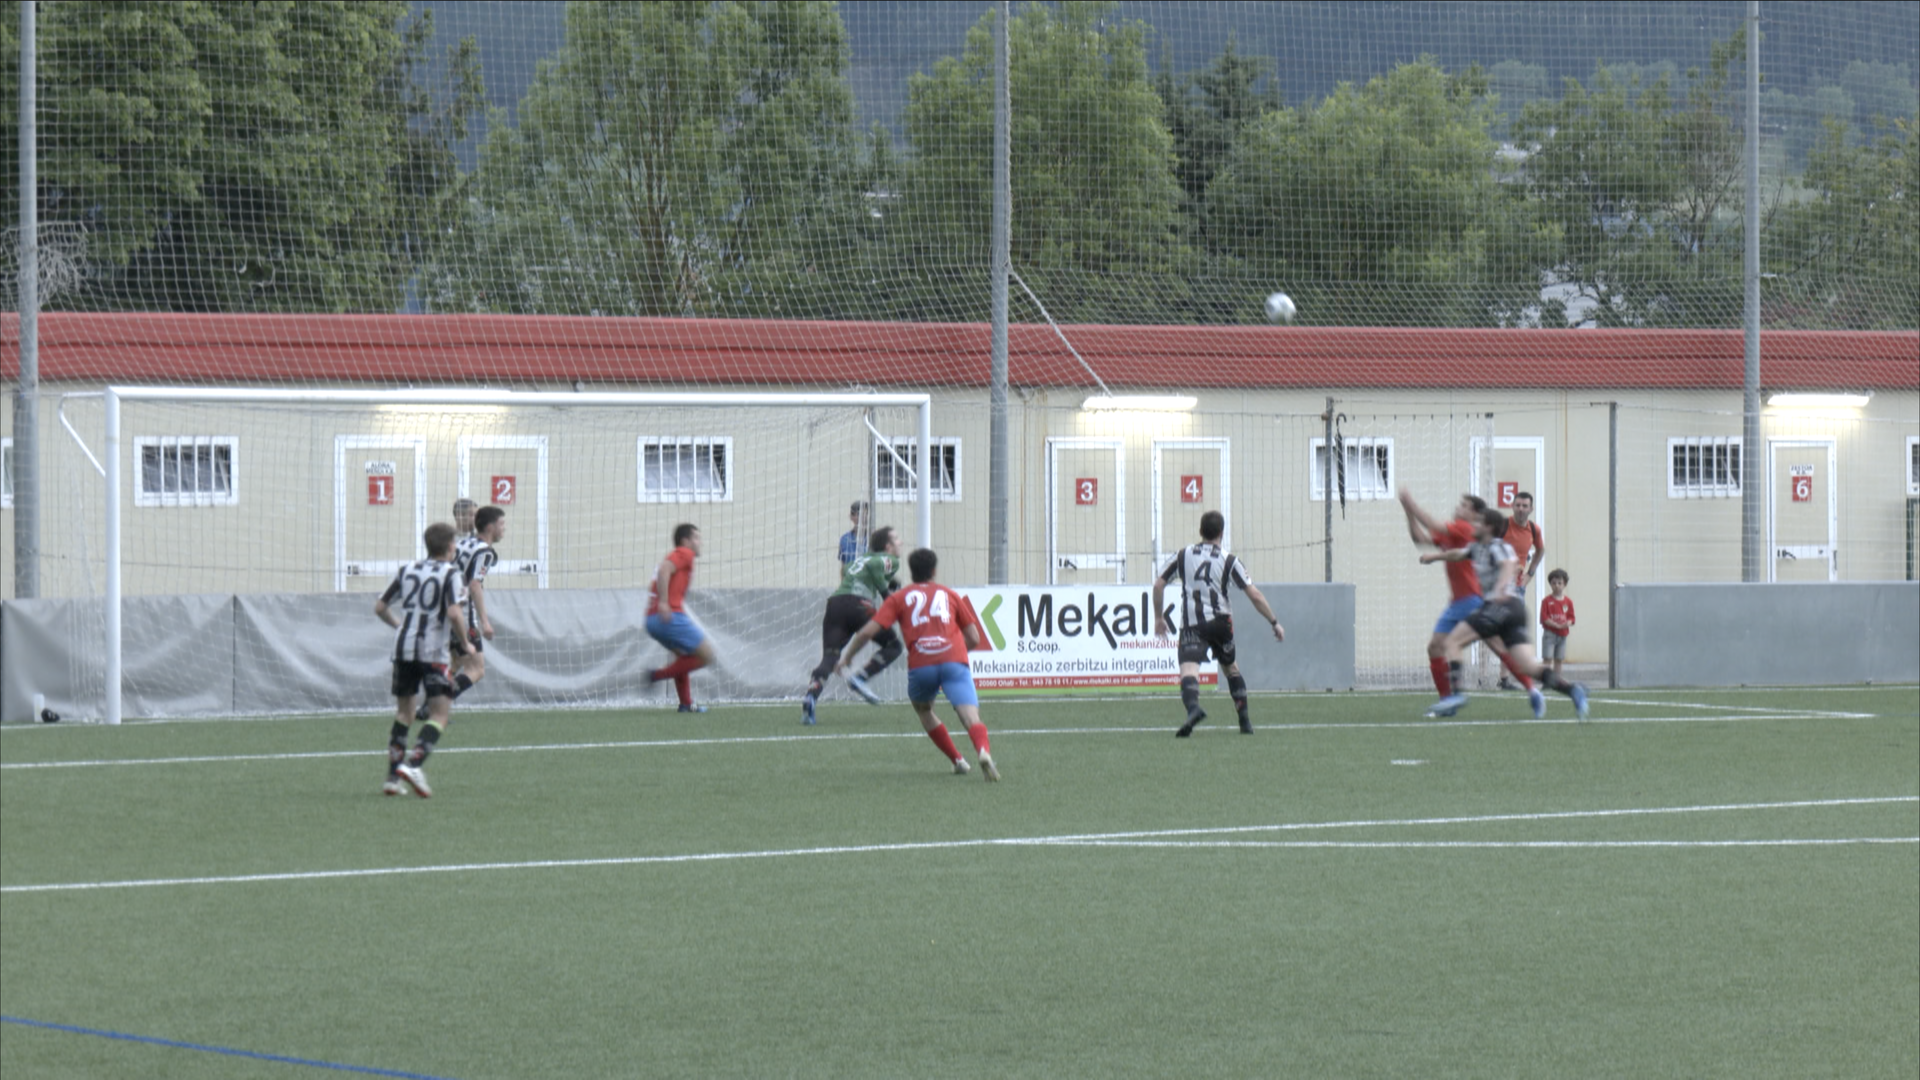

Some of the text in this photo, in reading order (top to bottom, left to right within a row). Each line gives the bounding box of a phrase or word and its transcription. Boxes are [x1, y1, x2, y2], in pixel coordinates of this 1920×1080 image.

[376, 480, 388, 501] 1
[496, 479, 511, 501] 2
[1080, 481, 1094, 501] 3
[1185, 478, 1199, 499] 4
[1503, 486, 1515, 504] 5
[1797, 480, 1808, 498] 6
[1194, 561, 1213, 586] 4
[402, 574, 440, 611] 20
[905, 590, 950, 627] 24
[1018, 592, 1178, 650] Mekalk
[1017, 640, 1060, 654] S.Coop.
[973, 656, 1175, 673] Mekanizazio zerbitzu integralak
